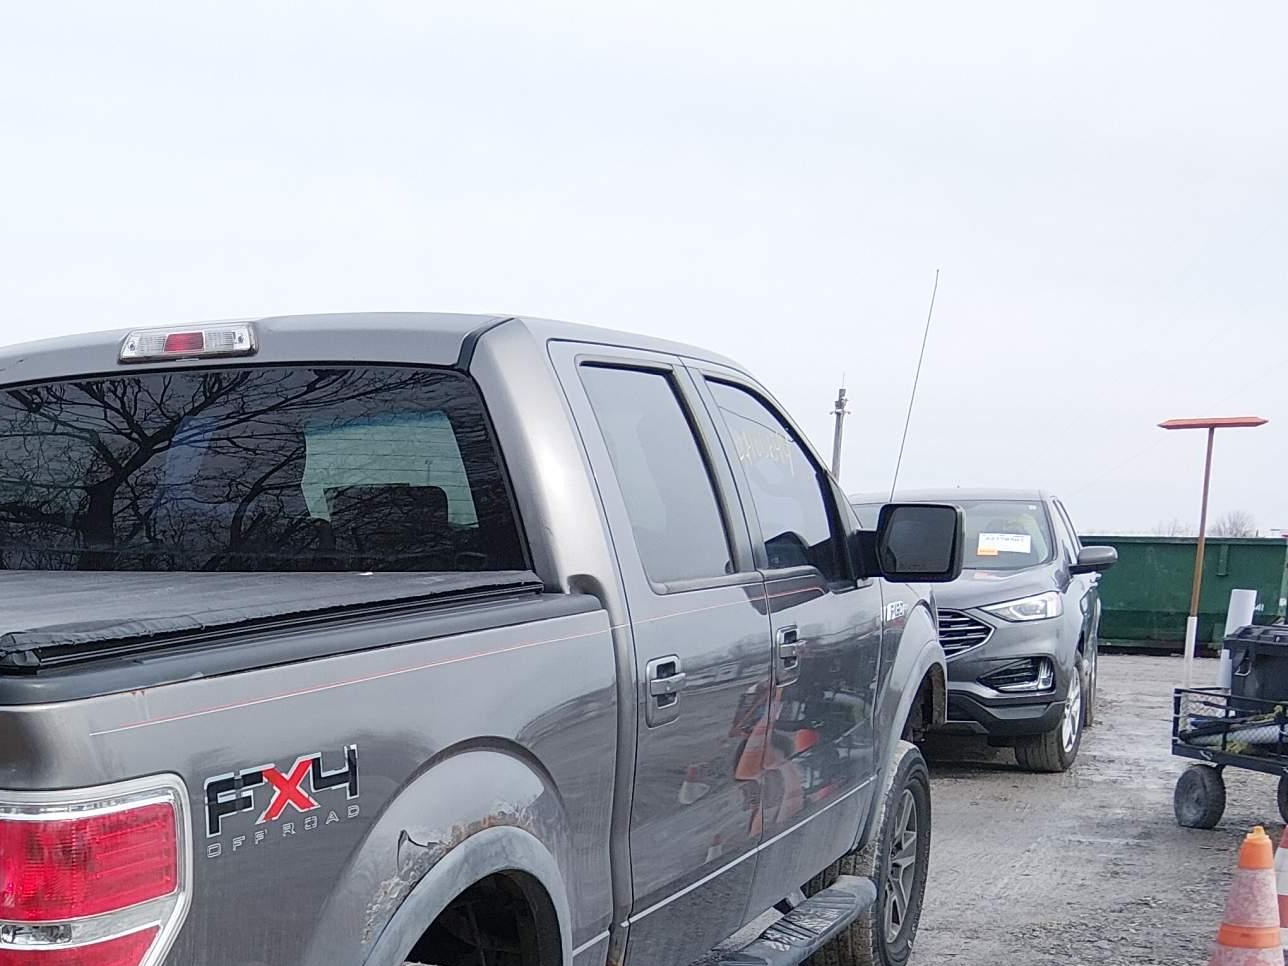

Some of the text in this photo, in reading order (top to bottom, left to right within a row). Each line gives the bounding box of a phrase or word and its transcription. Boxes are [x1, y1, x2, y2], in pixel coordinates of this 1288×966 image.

[204, 743, 360, 838] FX4
[206, 804, 360, 858] OFF ROAD
